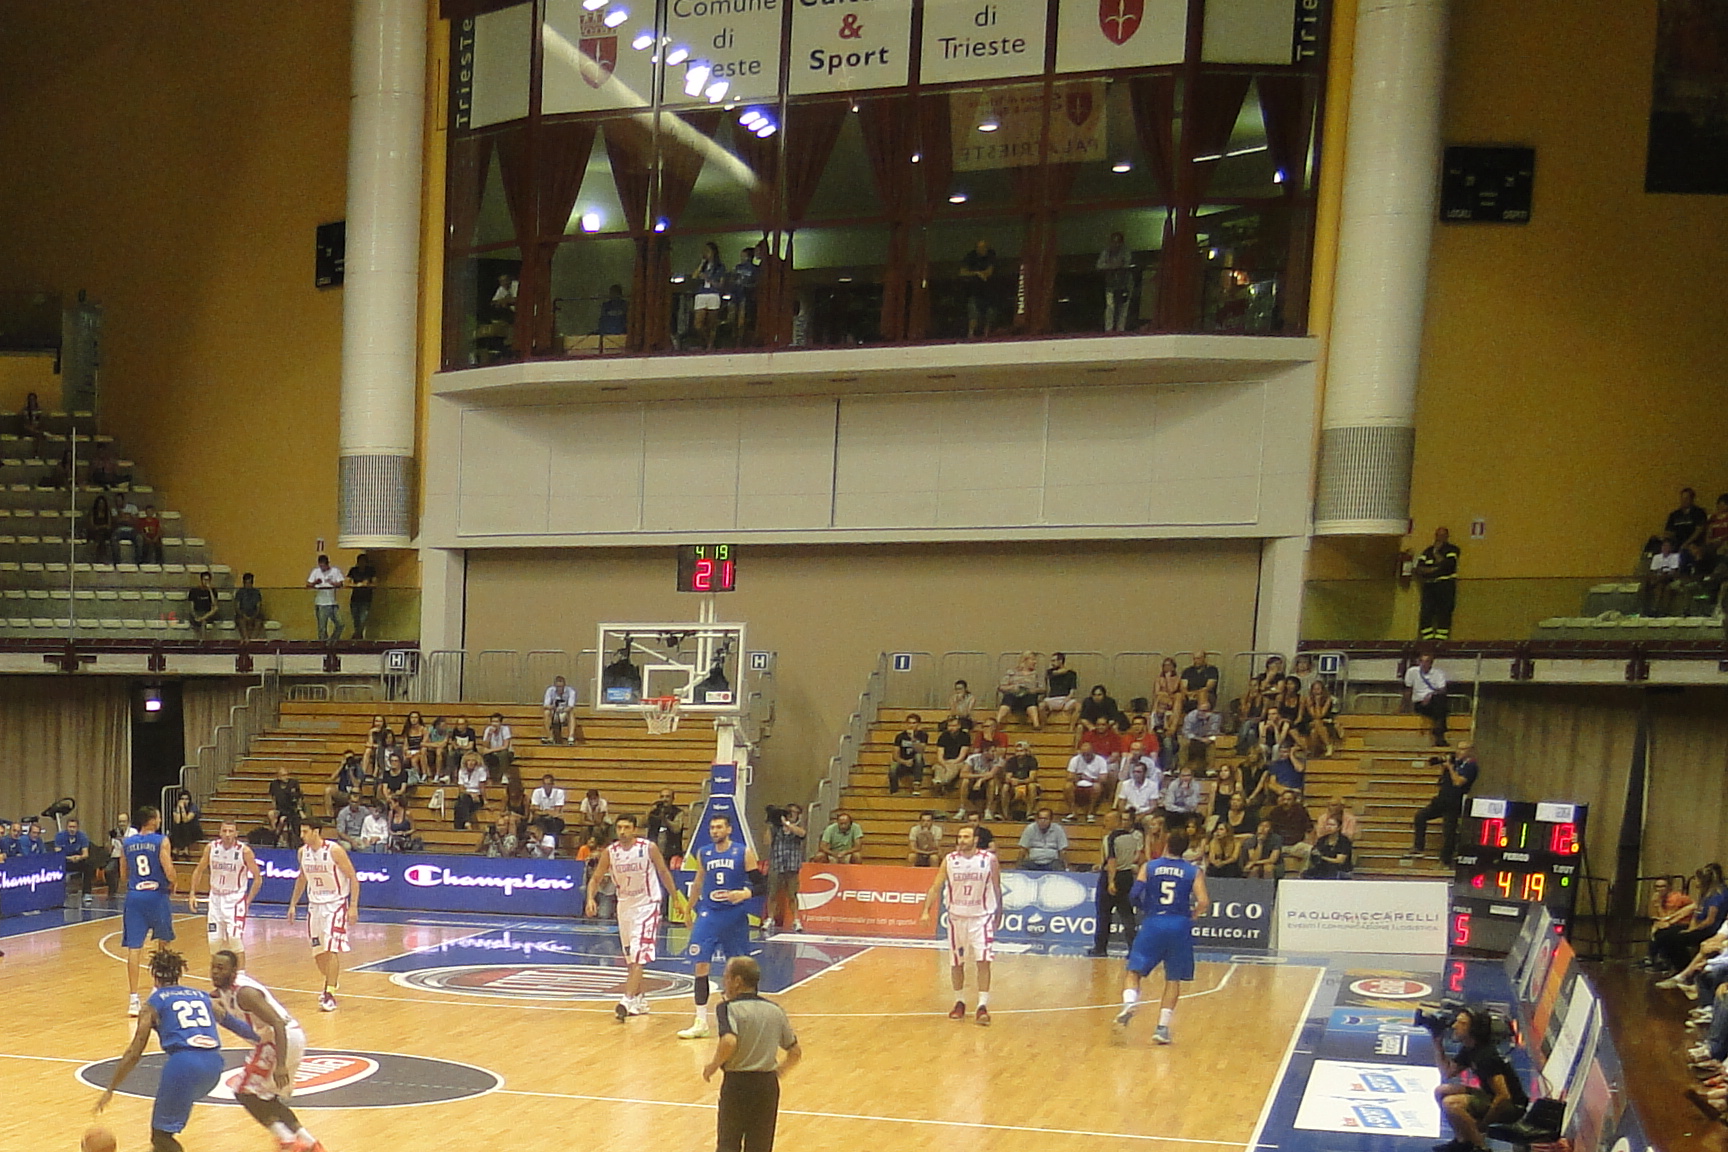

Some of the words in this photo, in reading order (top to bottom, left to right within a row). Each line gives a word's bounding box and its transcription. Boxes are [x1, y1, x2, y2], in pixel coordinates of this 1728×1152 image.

[839, 13, 864, 39] &
[975, 5, 997, 27] di
[713, 28, 734, 49] di
[937, 35, 1026, 60] Trieste
[683, 59, 761, 80] Teste
[809, 47, 889, 75] Sport
[695, 545, 705, 560] 4
[715, 544, 729, 560] 19
[693, 558, 733, 590] 21
[136, 855, 150, 876] 8
[706, 859, 735, 871] ITALIA
[404, 864, 574, 895] Champion
[715, 872, 725, 885] 9
[1498, 871, 1512, 898] 4
[1522, 873, 1545, 902] 19
[1160, 881, 1177, 905] 5
[1191, 925, 1261, 939] GELICO.IT
[1455, 914, 1469, 945] 5
[172, 1000, 212, 1028] 23
